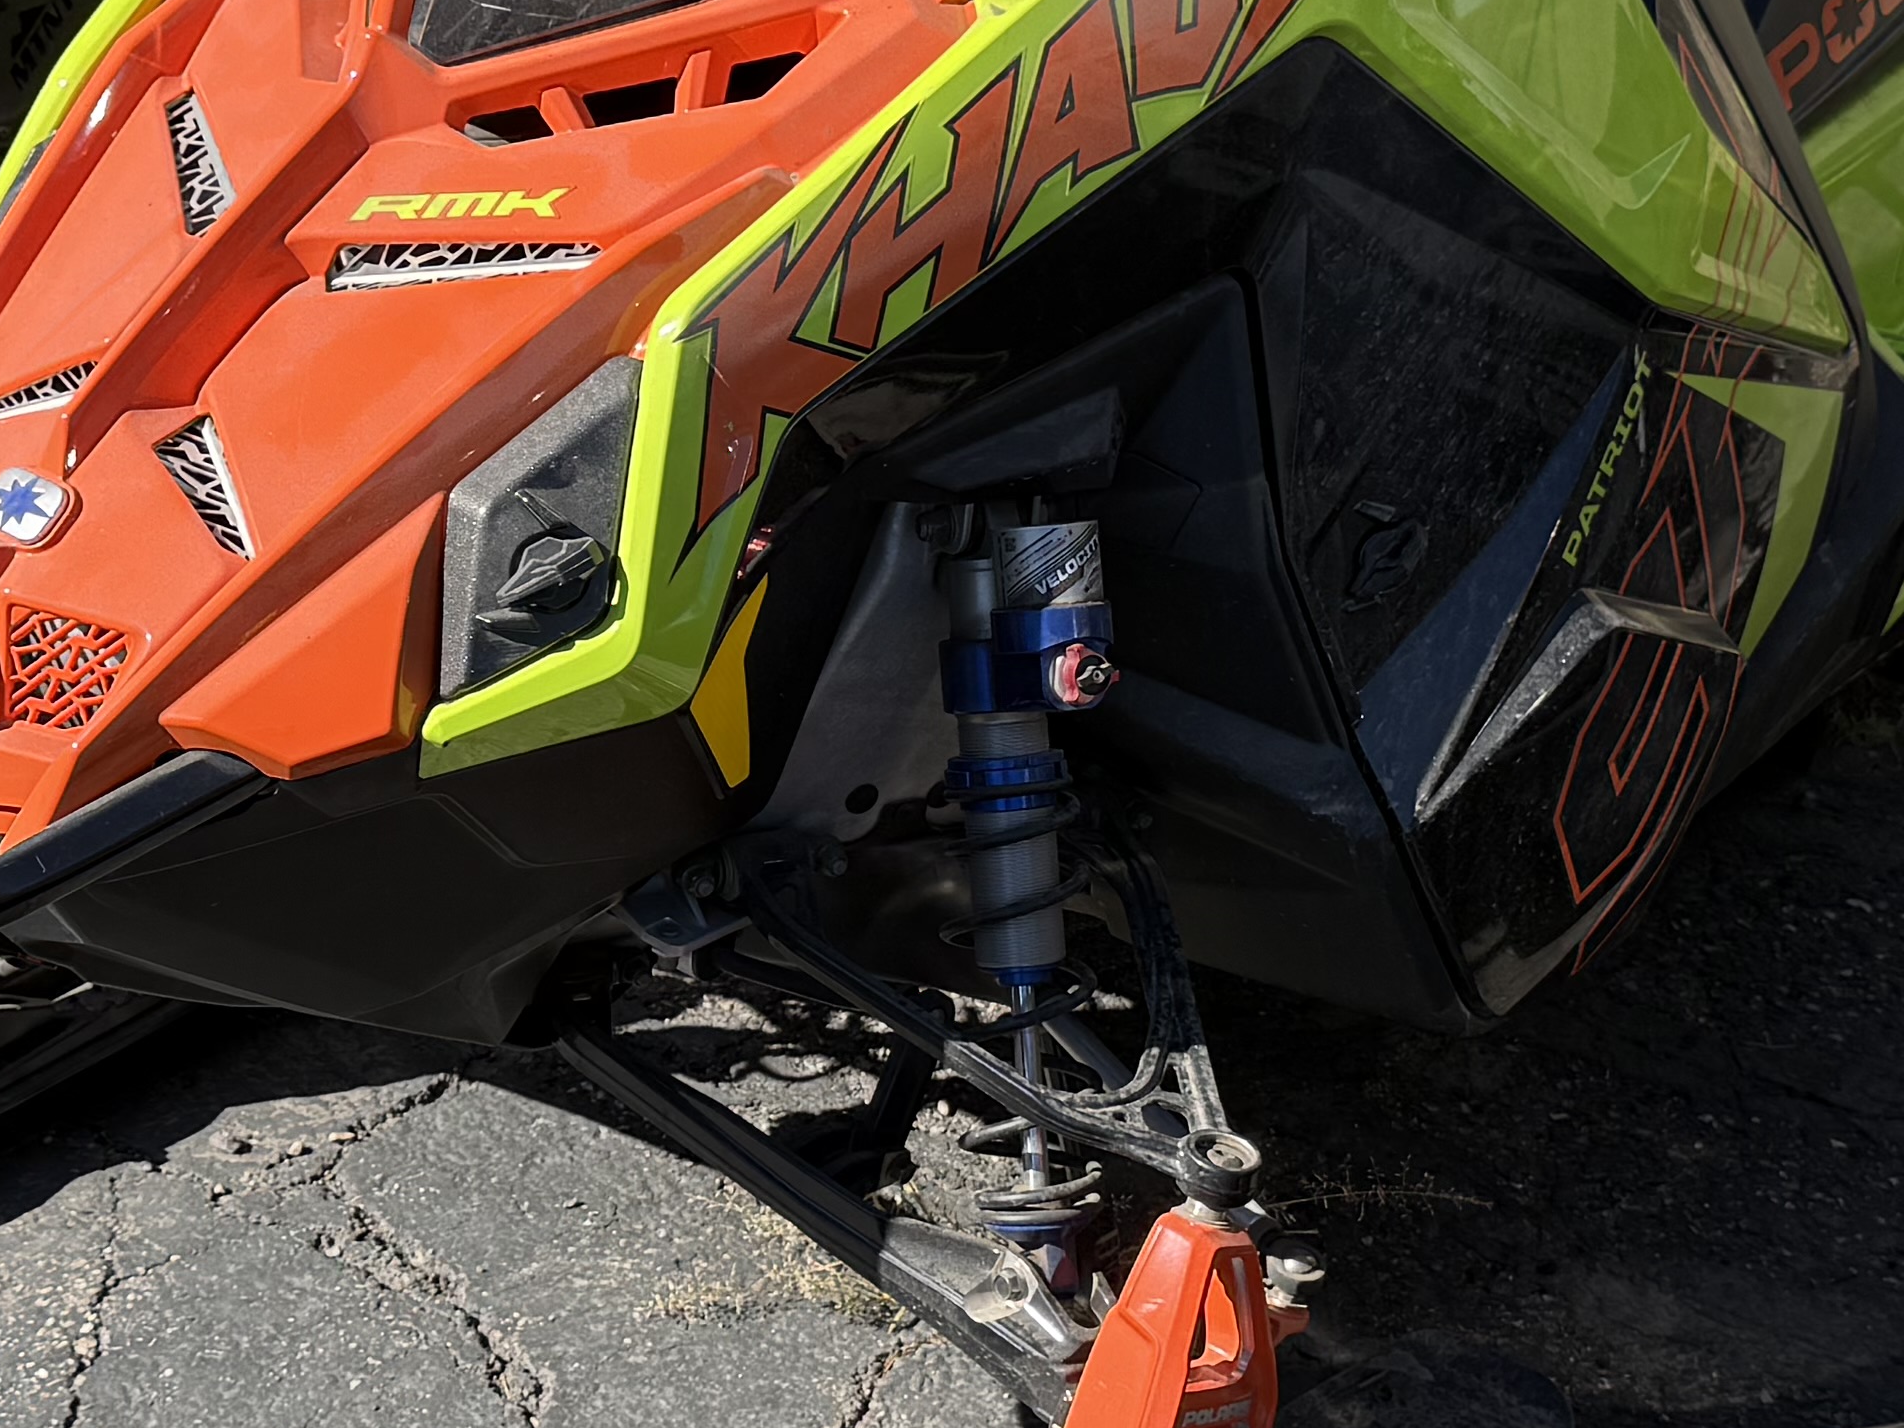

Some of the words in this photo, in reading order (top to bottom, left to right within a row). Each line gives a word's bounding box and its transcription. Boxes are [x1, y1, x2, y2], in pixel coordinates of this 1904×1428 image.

[348, 186, 573, 222] RMK
[1561, 349, 1652, 568] PATRIOT
[1034, 533, 1099, 596] VELOCIT
